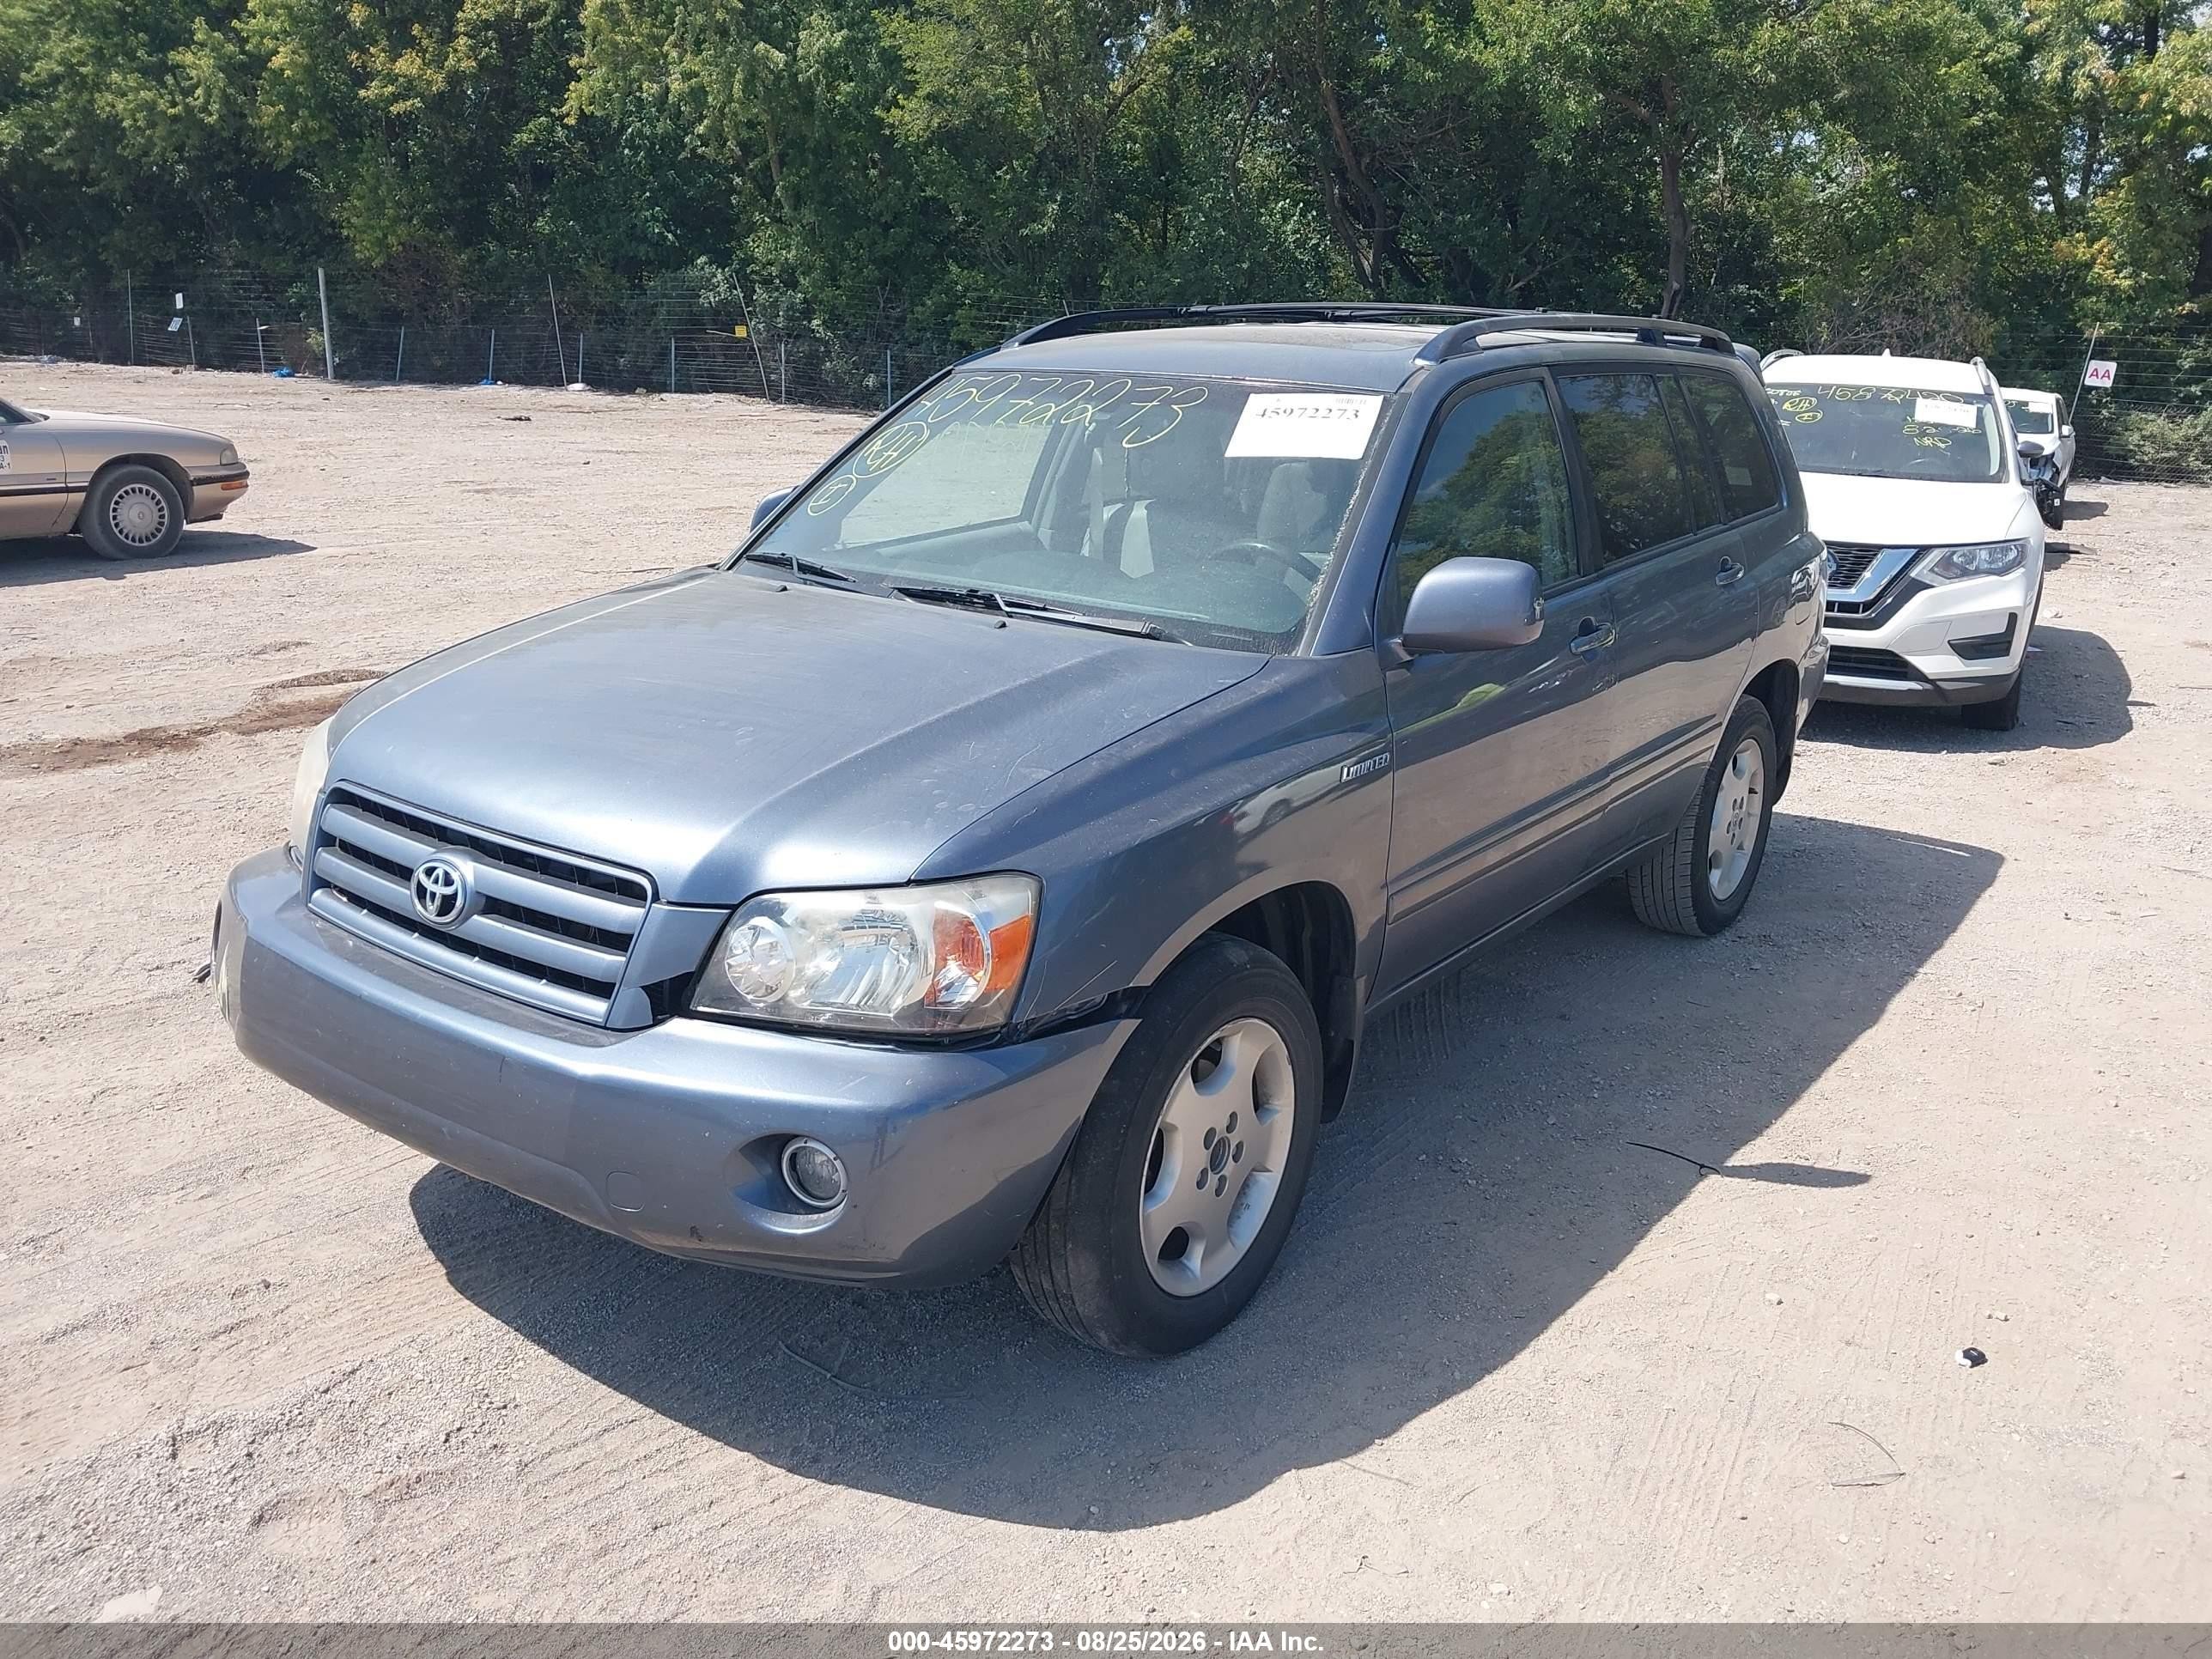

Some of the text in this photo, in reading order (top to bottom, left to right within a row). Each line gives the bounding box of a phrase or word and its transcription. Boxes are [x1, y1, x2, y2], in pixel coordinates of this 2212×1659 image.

[2088, 368, 2112, 380] AA
[914, 374, 1208, 447] 45972273
[1255, 407, 1359, 420] 45972273
